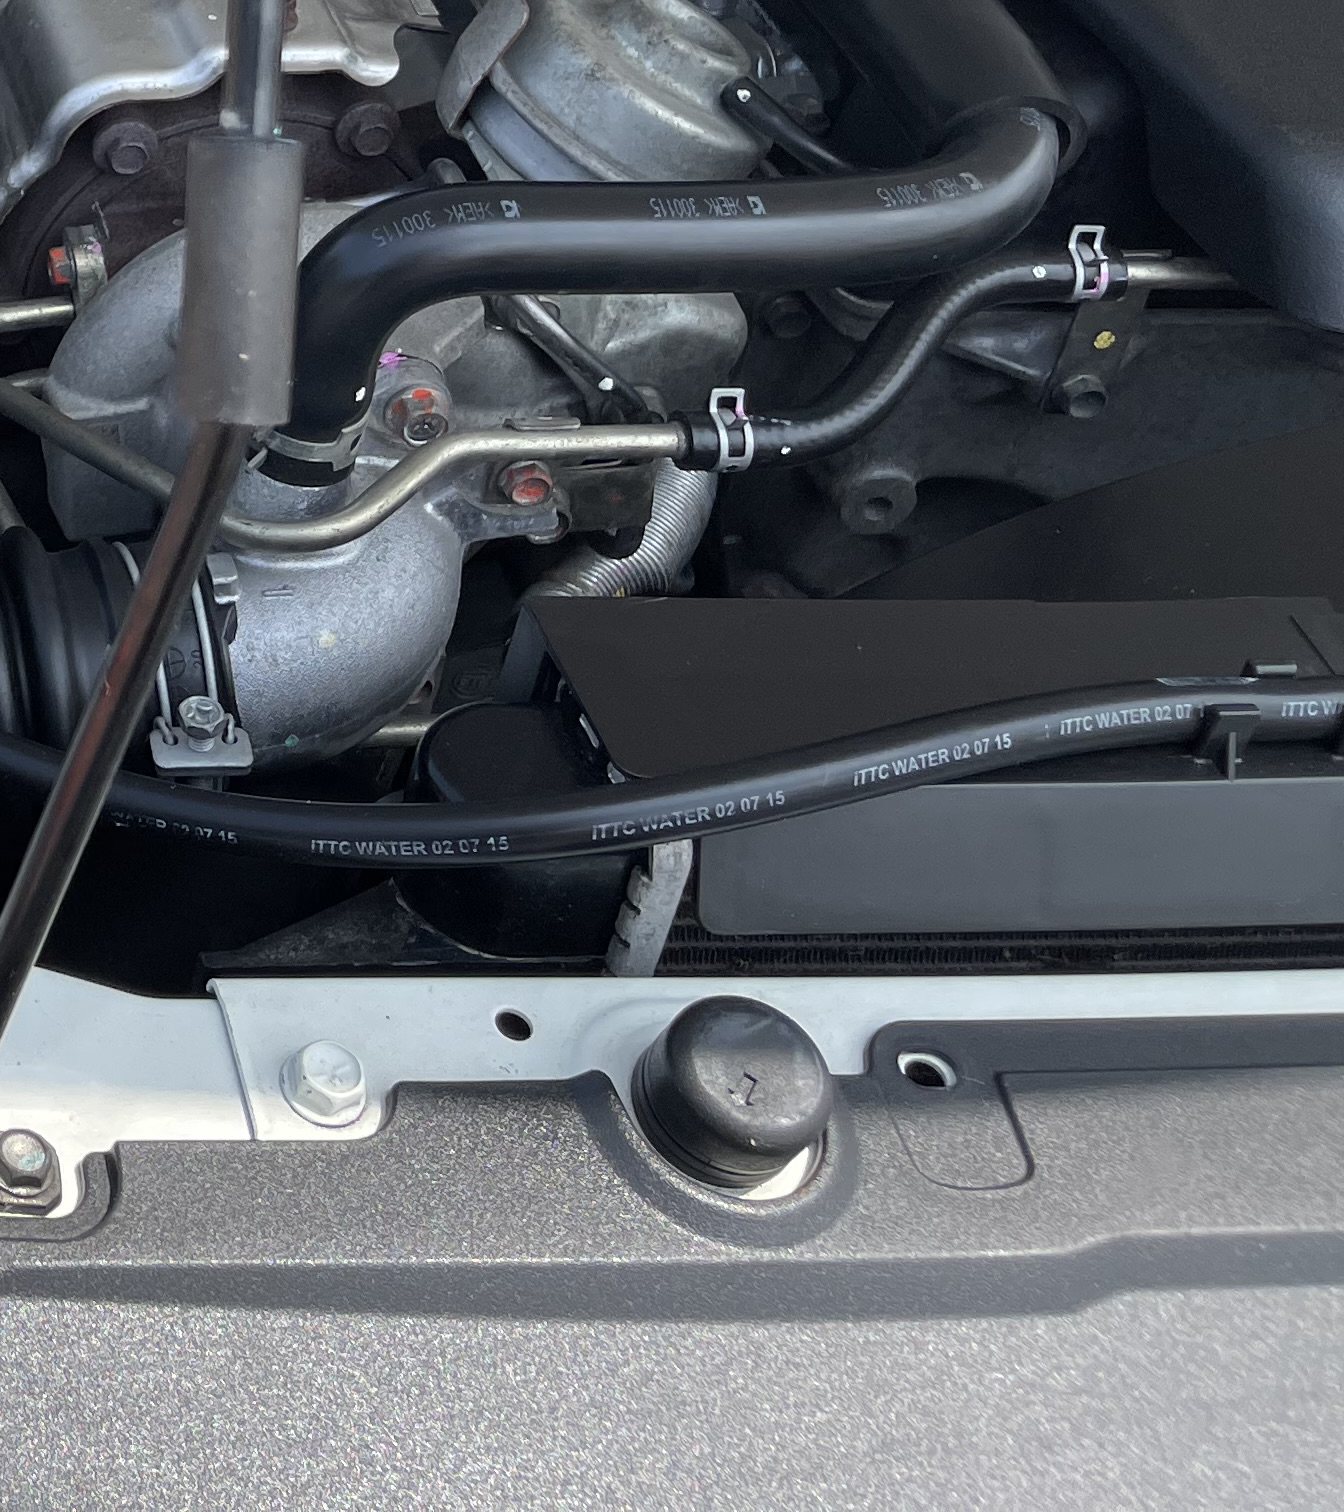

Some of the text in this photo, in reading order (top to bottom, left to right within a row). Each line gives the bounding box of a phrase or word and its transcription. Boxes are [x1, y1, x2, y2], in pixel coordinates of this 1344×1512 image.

[371, 209, 437, 248] 300115
[1095, 707, 1151, 729] WATER
[1154, 705, 1173, 721] 02
[1175, 703, 1193, 720] 07
[891, 748, 950, 776] WATER
[953, 743, 971, 761] 02
[974, 738, 990, 755] 07
[994, 732, 1012, 749] 15
[638, 806, 711, 832] WATER
[714, 801, 736, 819] 02
[740, 795, 760, 812] 07
[766, 790, 786, 807] 15
[355, 840, 429, 856] WATER
[431, 840, 455, 855] 02
[486, 835, 510, 852] 15
